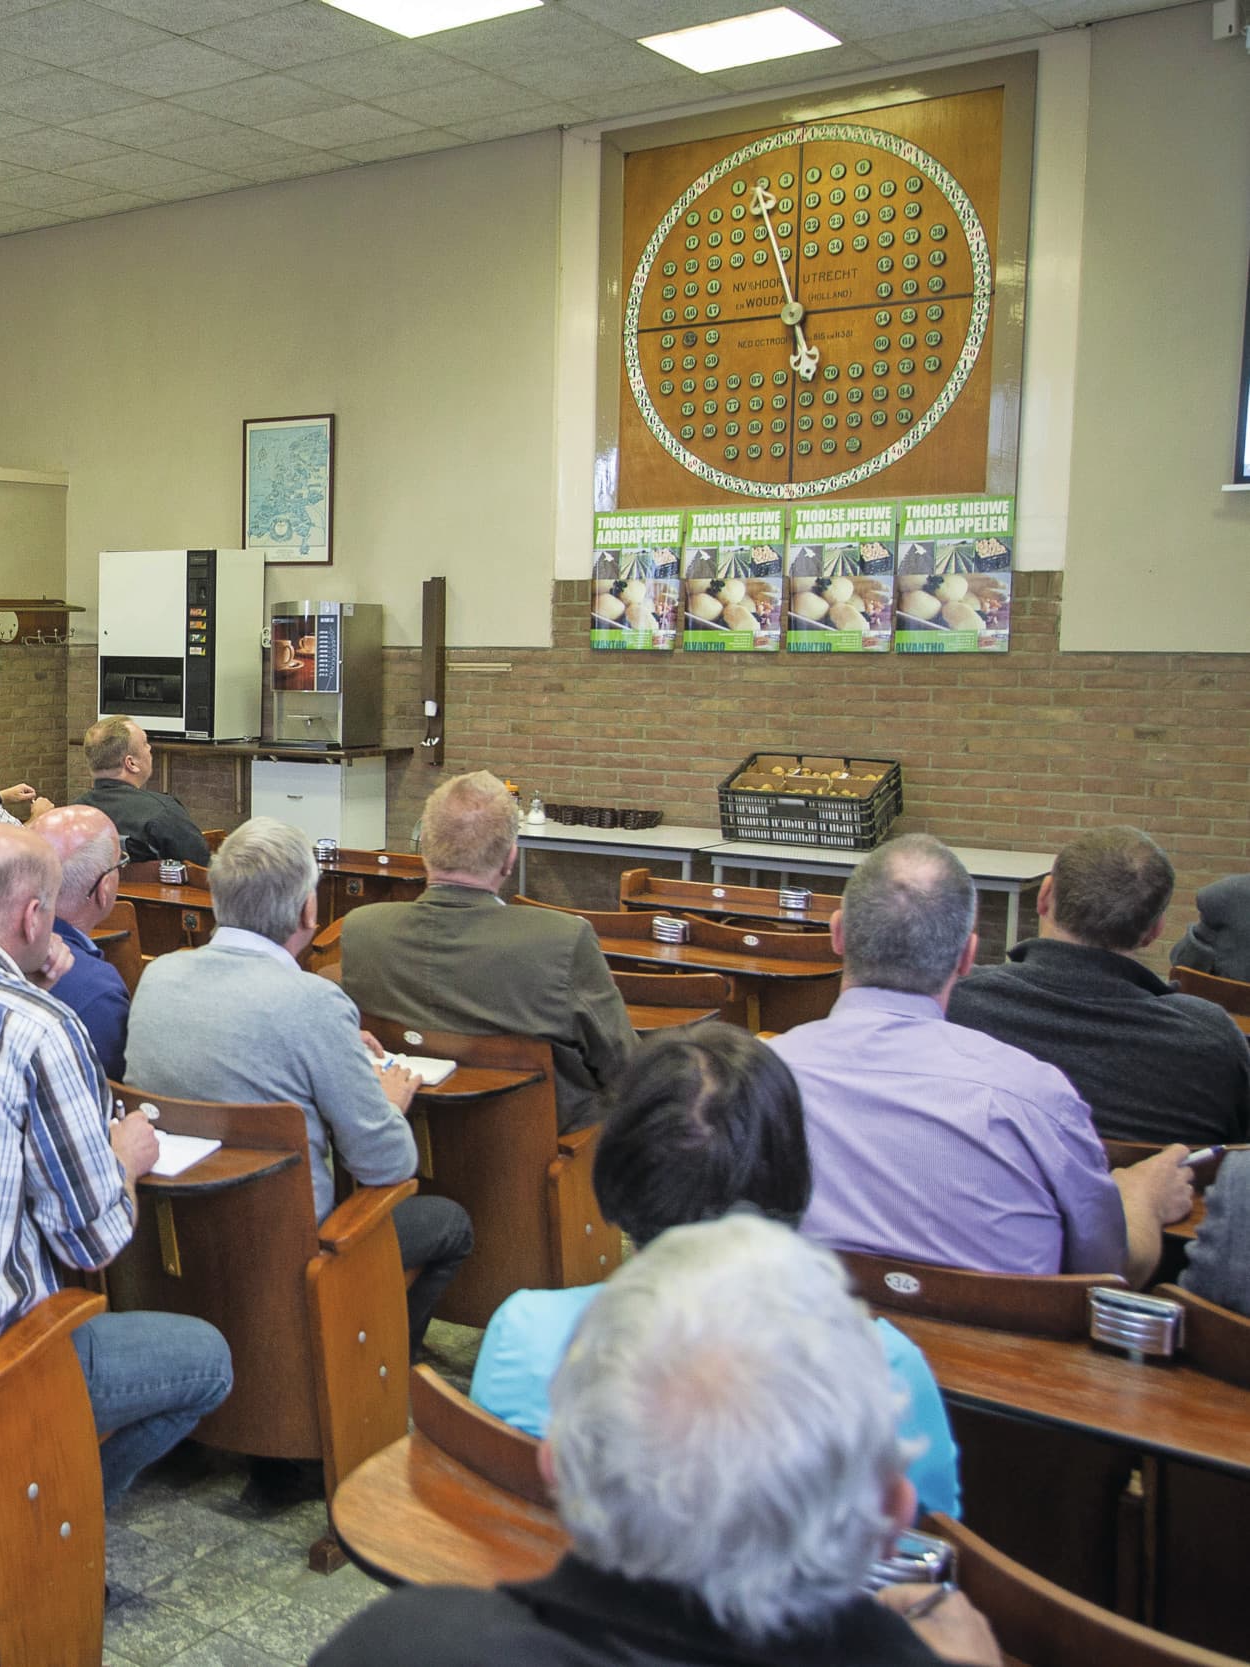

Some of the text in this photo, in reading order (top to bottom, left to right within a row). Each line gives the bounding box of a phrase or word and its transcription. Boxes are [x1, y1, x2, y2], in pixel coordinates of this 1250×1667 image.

[909, 179, 918, 188] 16
[858, 188, 866, 197] 14
[883, 184, 892, 193] 15
[833, 192, 841, 200] 13
[952, 190, 958, 199] 6
[782, 201, 788, 209] 11
[808, 196, 816, 205] 12
[958, 200, 965, 210] 7
[881, 209, 891, 218] 25
[907, 205, 917, 214] 26
[856, 213, 866, 222] 24
[963, 210, 970, 219] 8
[806, 221, 817, 229] 22
[831, 217, 841, 226] 23
[968, 220, 975, 229] 9
[756, 228, 766, 237] 20
[780, 225, 788, 234] 21
[933, 228, 943, 236] 38
[711, 235, 718, 243] 18
[734, 232, 742, 240] 19
[881, 235, 891, 243] 36
[906, 231, 916, 240] 37
[969, 231, 981, 240] 20
[688, 238, 696, 246] 17
[831, 242, 840, 250] 34
[855, 238, 865, 247] 35
[977, 242, 979, 251] 1
[806, 245, 815, 254] 33
[733, 256, 742, 264] 30
[756, 253, 764, 261] 31
[905, 257, 915, 266] 43
[932, 253, 942, 262] 44
[977, 253, 984, 263] 2
[687, 262, 696, 270] 28
[710, 259, 719, 267] 29
[880, 260, 890, 269] 42
[665, 264, 674, 273] 27
[978, 265, 986, 274] 3
[803, 268, 858, 284] UTRECHT
[930, 280, 941, 288] 50
[979, 276, 984, 286] 4
[687, 285, 696, 293] 40
[710, 283, 717, 291] 41
[879, 285, 889, 294] 48
[905, 282, 915, 291] 49
[665, 288, 674, 296] 39
[746, 295, 786, 308] WOUDA
[808, 288, 853, 303] (HOLLAND)
[709, 306, 717, 314] 47
[977, 301, 984, 310] 6
[664, 311, 673, 319] 45
[686, 308, 695, 317] 46
[903, 311, 913, 320] 55
[929, 308, 940, 317] 56
[878, 314, 887, 323] 54
[976, 313, 983, 323] 7
[973, 325, 981, 334] 8
[664, 337, 671, 345] 51
[708, 333, 717, 341] 53
[755, 336, 788, 347] OCTROOI
[902, 336, 911, 345] 61
[928, 334, 938, 343] 62
[971, 336, 978, 345] 9
[876, 339, 887, 347] 60
[964, 348, 975, 357] 30
[663, 360, 671, 368] 57
[685, 358, 694, 366] 58
[707, 356, 716, 364] 59
[927, 359, 937, 368] 74
[964, 360, 966, 369] 1
[875, 364, 885, 372] 72
[901, 361, 911, 370] 73
[826, 369, 836, 377] 70
[851, 367, 859, 375] 71
[957, 371, 964, 380] 2
[728, 377, 738, 385] 66
[751, 376, 761, 384] 67
[775, 373, 784, 382] 68
[662, 383, 671, 391] 63
[684, 381, 692, 389] 64
[950, 382, 958, 391] 3
[850, 391, 860, 399] 82
[874, 389, 884, 397] 83
[900, 387, 910, 396] 84
[801, 395, 811, 403] 80
[826, 393, 834, 401] 81
[944, 392, 949, 402] 4
[728, 401, 737, 409] 77
[751, 399, 761, 407] 78
[774, 398, 784, 406] 79
[683, 405, 692, 413] 75
[705, 403, 715, 411] 76
[849, 415, 859, 424] 92
[873, 414, 883, 422] 93
[899, 412, 909, 420] 94
[929, 413, 935, 421] 6
[750, 423, 760, 431] 88
[774, 421, 783, 430] 89
[800, 419, 810, 427] 90
[921, 422, 928, 432] 7
[683, 428, 691, 436] 85
[705, 426, 714, 434] 86
[727, 425, 736, 433] 87
[912, 431, 919, 439] 8
[799, 443, 809, 451] 98
[904, 439, 910, 448] 9
[749, 447, 759, 455] 96
[906, 501, 1009, 518] THOOLSE NIEUWE
[692, 511, 781, 527] THOOLSE NIEUWE
[796, 507, 892, 522] THOOLSE NIEUWE
[597, 514, 680, 529] THOOLSE NIEUWE
[904, 515, 1009, 536] AARDAPPELEN
[691, 524, 780, 542] AARDAPPELEN
[795, 520, 891, 539] AARDAPPELEN
[596, 528, 678, 544] AARDAPPELEN
[893, 1276, 911, 1290] 34
